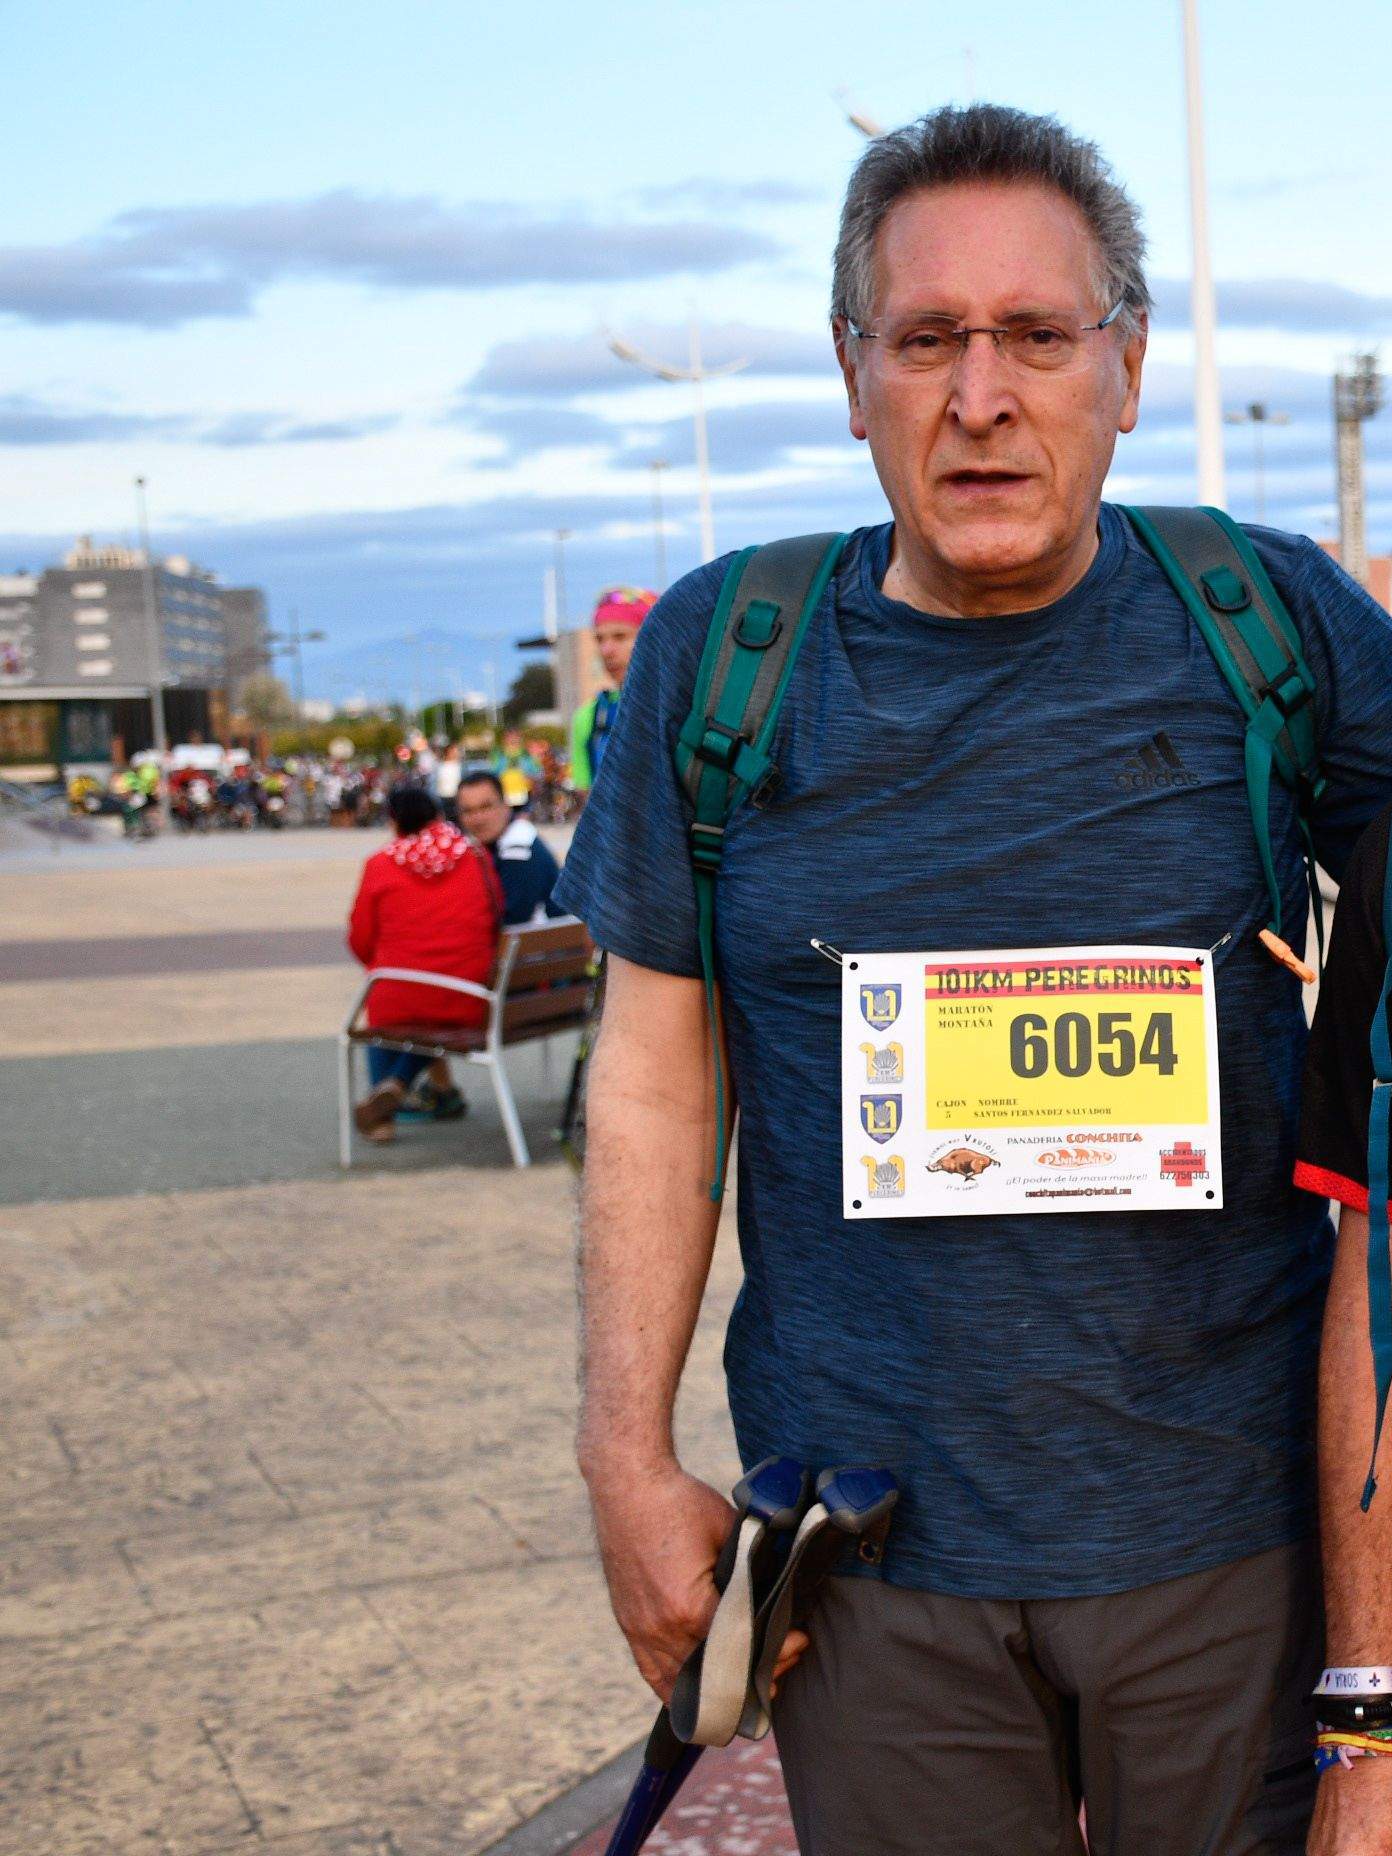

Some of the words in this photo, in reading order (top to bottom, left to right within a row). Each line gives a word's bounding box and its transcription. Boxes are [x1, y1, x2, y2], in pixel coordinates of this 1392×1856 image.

[937, 966, 1014, 995] 101KM
[1025, 963, 1192, 994] PEREGRINOS
[1009, 1011, 1180, 1081] 6054
[978, 1098, 1019, 1107] NOMBRE
[974, 1110, 1008, 1118] SANTOS
[1011, 1109, 1063, 1118] FERNANDEZ
[1065, 1107, 1112, 1116] SALVADOR
[1007, 1135, 1063, 1145] PANADERIA
[1066, 1132, 1143, 1144] CONCHITA
[1023, 1176, 1051, 1185] poder
